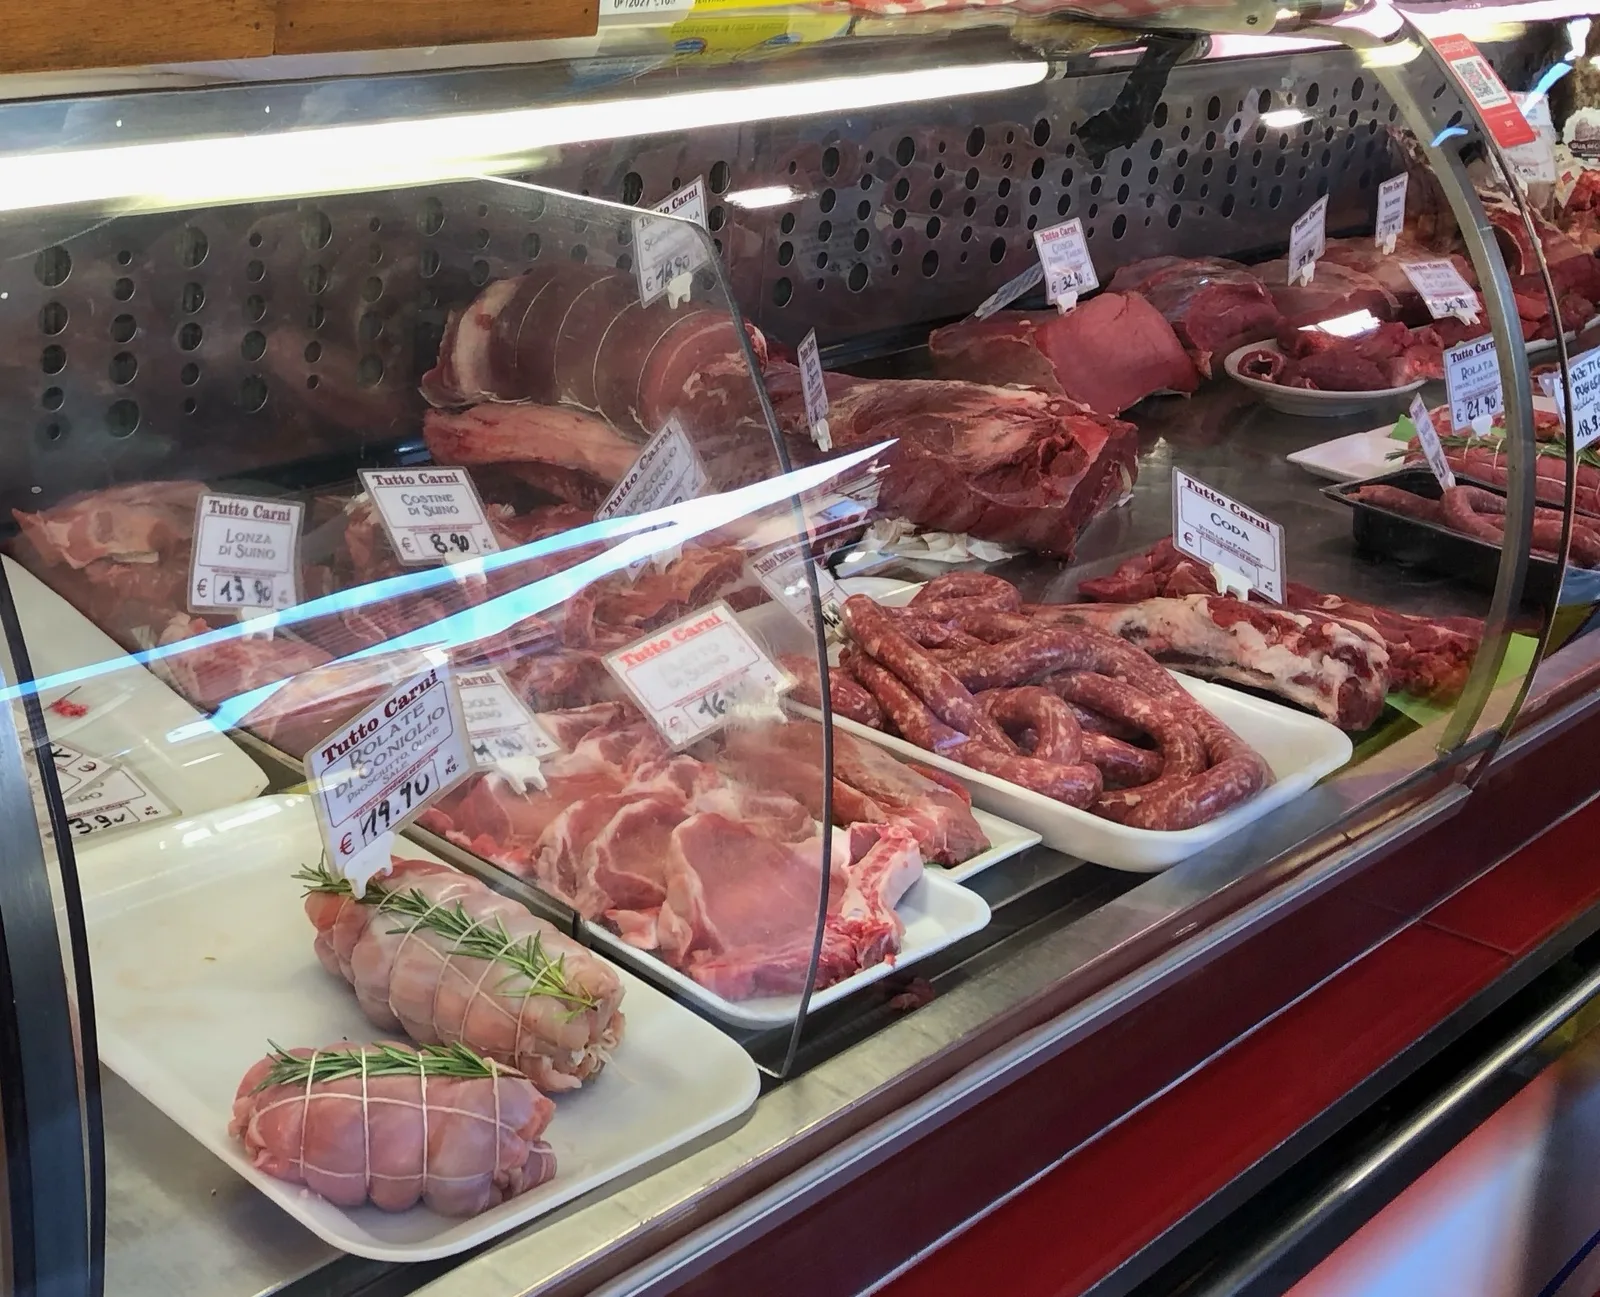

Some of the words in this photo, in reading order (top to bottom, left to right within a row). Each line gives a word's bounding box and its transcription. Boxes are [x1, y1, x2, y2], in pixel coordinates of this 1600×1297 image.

[672, 185, 698, 210] Carni
[1040, 230, 1059, 242] Tutto
[1060, 224, 1077, 237] Carni
[1451, 348, 1474, 363] Tutto
[1475, 340, 1496, 353] Carn
[1456, 408, 1462, 423] €
[1467, 395, 1496, 421] 21.90
[372, 474, 415, 486] Tutto
[418, 472, 460, 484] Carni
[604, 473, 638, 517] Tutto
[639, 426, 673, 471] Carni
[209, 500, 249, 517] Tutto
[253, 504, 291, 521] Carni
[408, 506, 420, 516] DI
[422, 504, 460, 517] SUINO
[1184, 477, 1225, 507] Tutto
[1230, 503, 1271, 533] Carni
[226, 528, 272, 544] LONZA
[1210, 512, 1250, 541] CODA
[401, 536, 415, 553] €
[430, 533, 470, 553] 8.90
[1183, 531, 1194, 547] €
[219, 545, 231, 556] DI
[235, 544, 276, 560] SUINO
[753, 560, 777, 575] Tutto
[196, 578, 208, 598] €
[619, 639, 671, 667] Tutto
[672, 612, 722, 642] Carni
[321, 718, 380, 765] Tutto
[383, 668, 439, 719] Carni
[349, 701, 426, 770] ROLATE
[335, 777, 353, 799] DI
[359, 705, 446, 780] CONIGLIO
[446, 755, 454, 765] al
[382, 760, 410, 785] SALE
[339, 831, 355, 855] €
